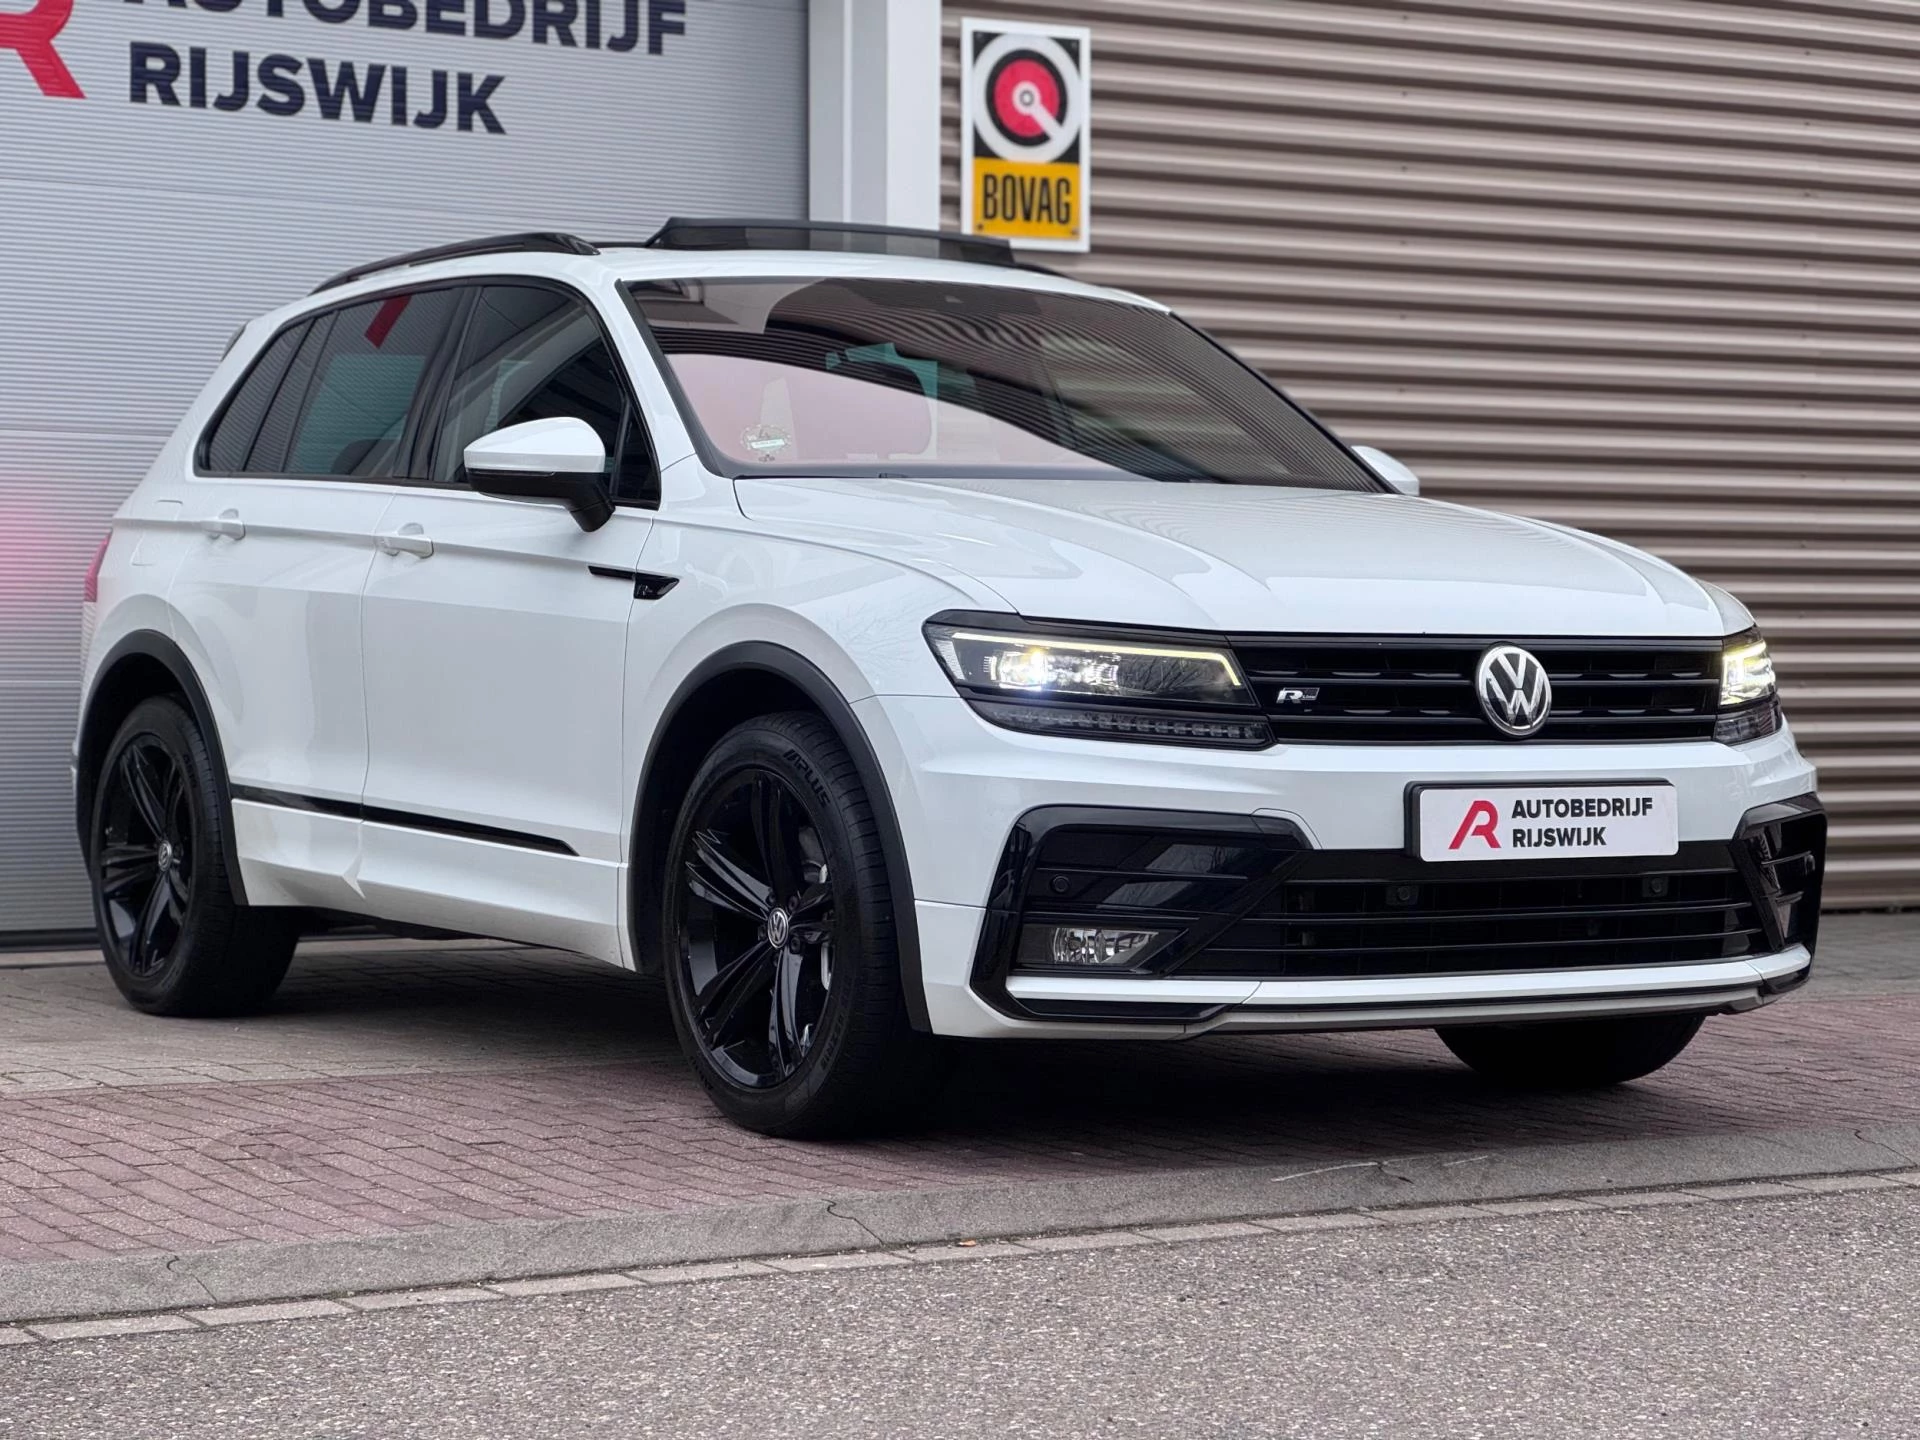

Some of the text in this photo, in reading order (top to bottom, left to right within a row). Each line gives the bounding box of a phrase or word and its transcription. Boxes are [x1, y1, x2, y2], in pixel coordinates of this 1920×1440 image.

[124, 0, 686, 55] EDRIJF
[129, 41, 506, 134] RIJSWIJK
[982, 174, 1071, 225] BOVAG
[1511, 797, 1653, 819] AUTOBEDRIJF
[1512, 827, 1607, 848] RIJSWIJK
